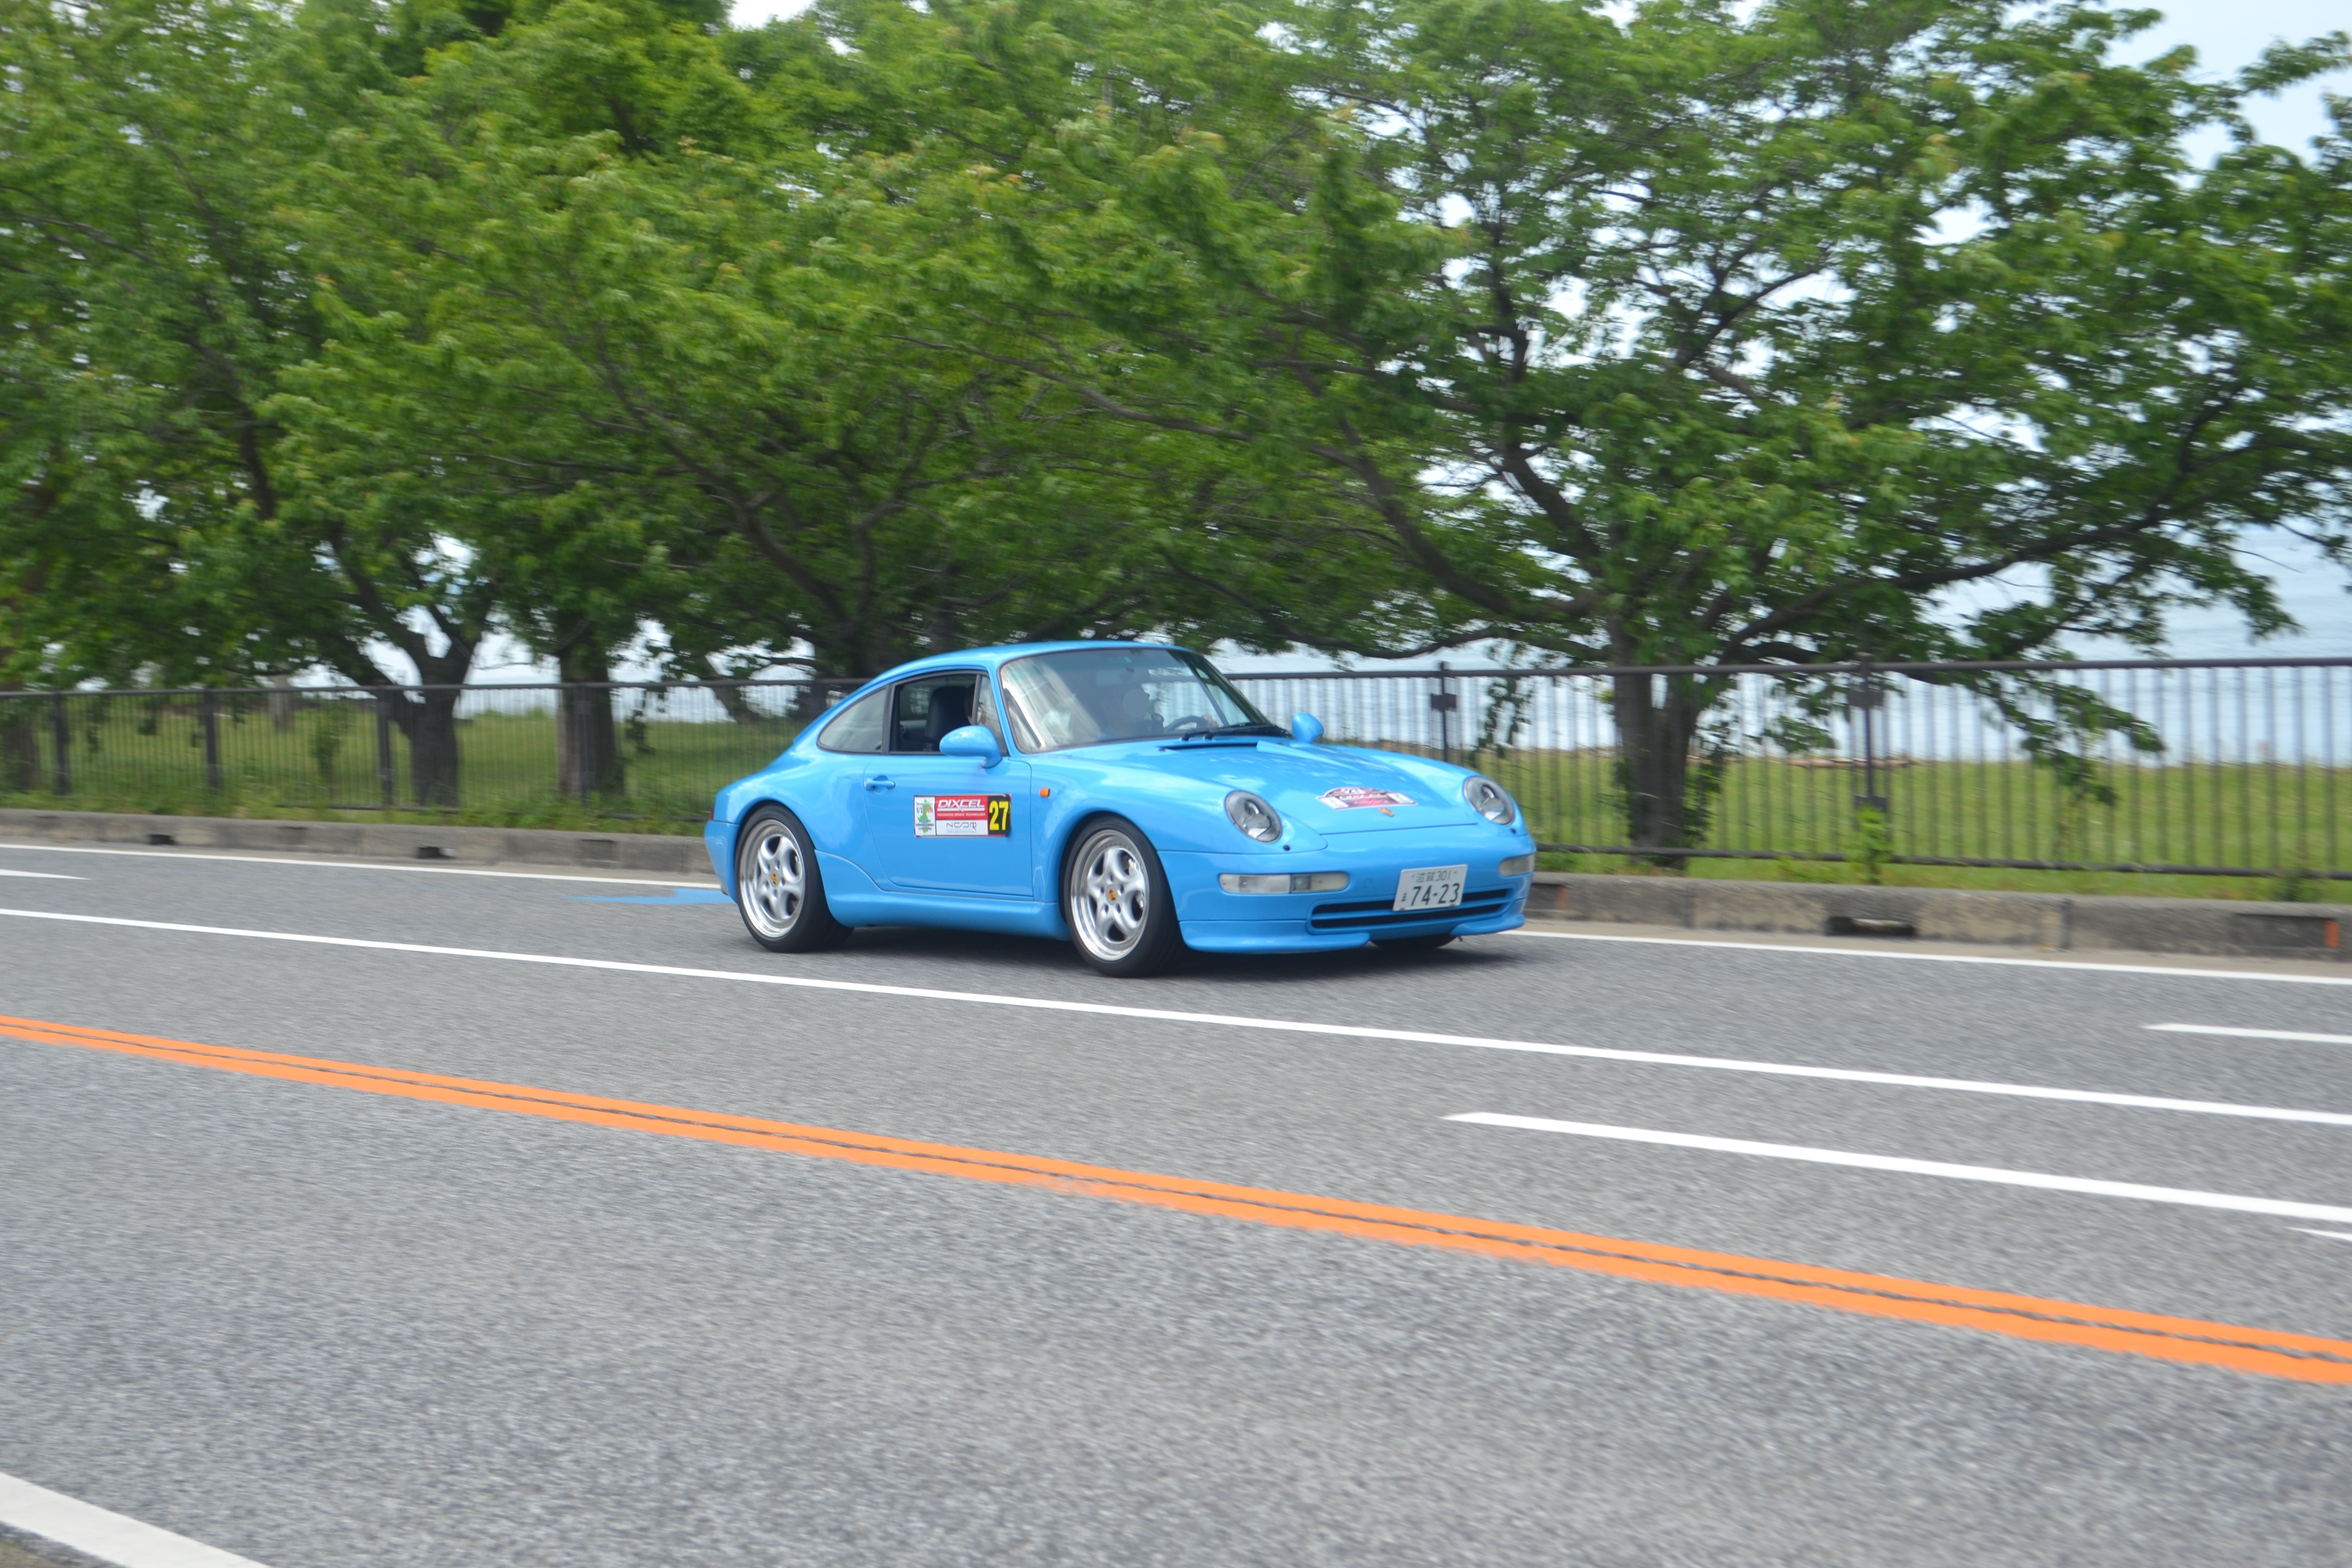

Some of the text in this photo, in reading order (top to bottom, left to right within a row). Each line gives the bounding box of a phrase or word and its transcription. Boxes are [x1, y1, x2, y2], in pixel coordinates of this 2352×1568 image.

[937, 798, 985, 812] DIXCEL
[989, 800, 1009, 830] 27
[1410, 883, 1460, 907] 74-23
